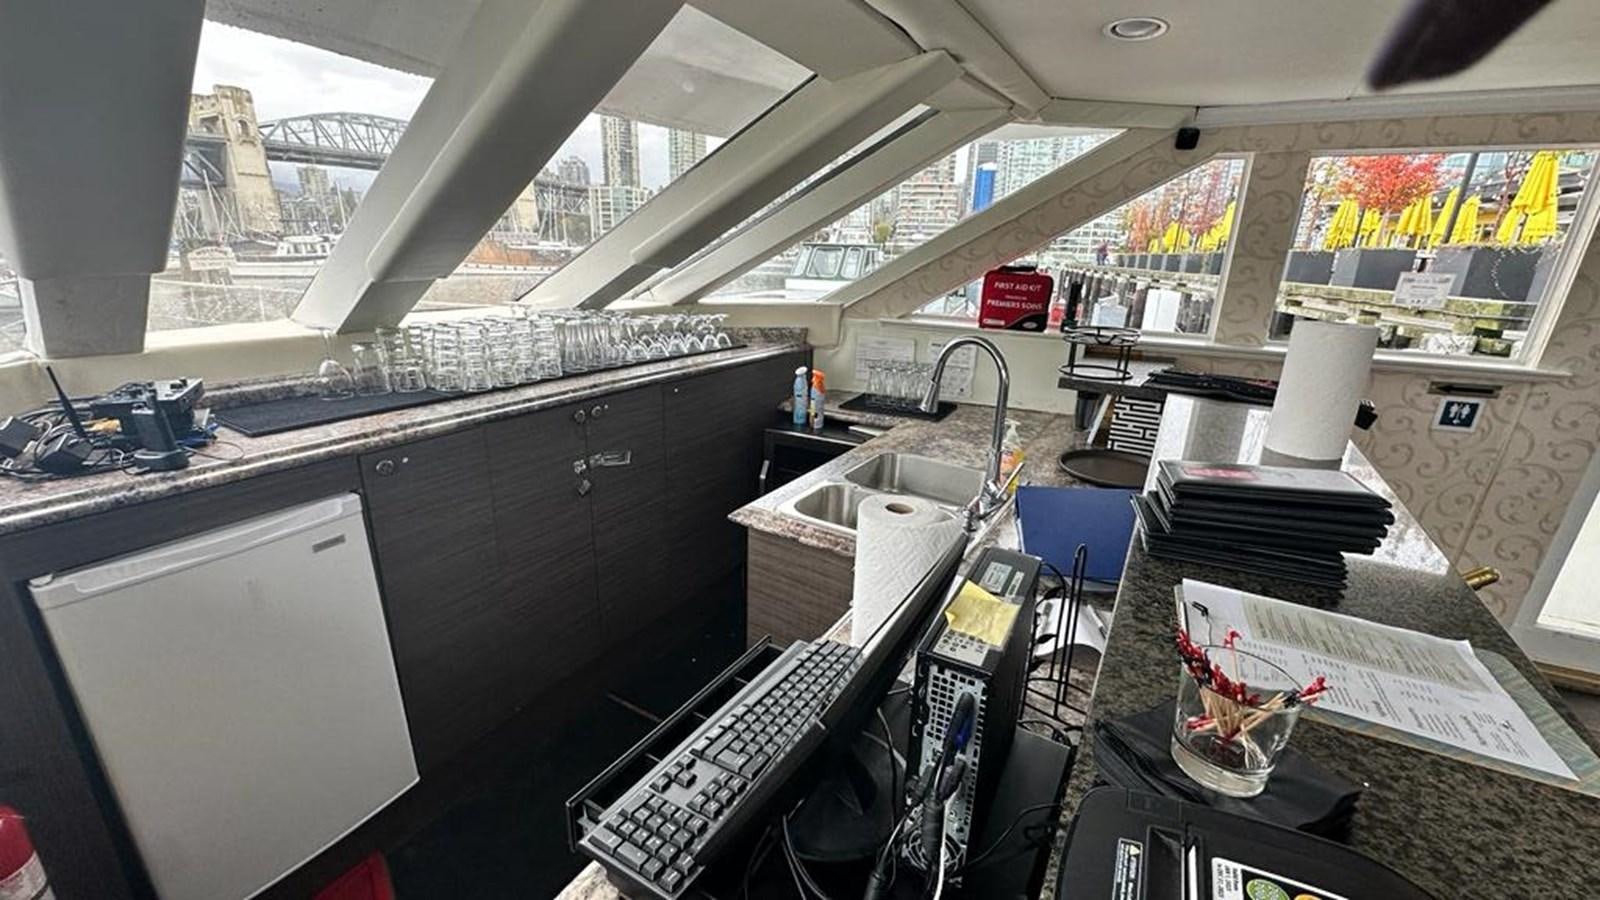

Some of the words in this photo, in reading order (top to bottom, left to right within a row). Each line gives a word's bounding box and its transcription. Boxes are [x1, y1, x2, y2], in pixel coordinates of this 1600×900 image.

[994, 281, 1014, 290] FIRST
[1014, 283, 1029, 291] AID
[1029, 284, 1042, 292] KIT
[987, 299, 1021, 309] PREMIERS
